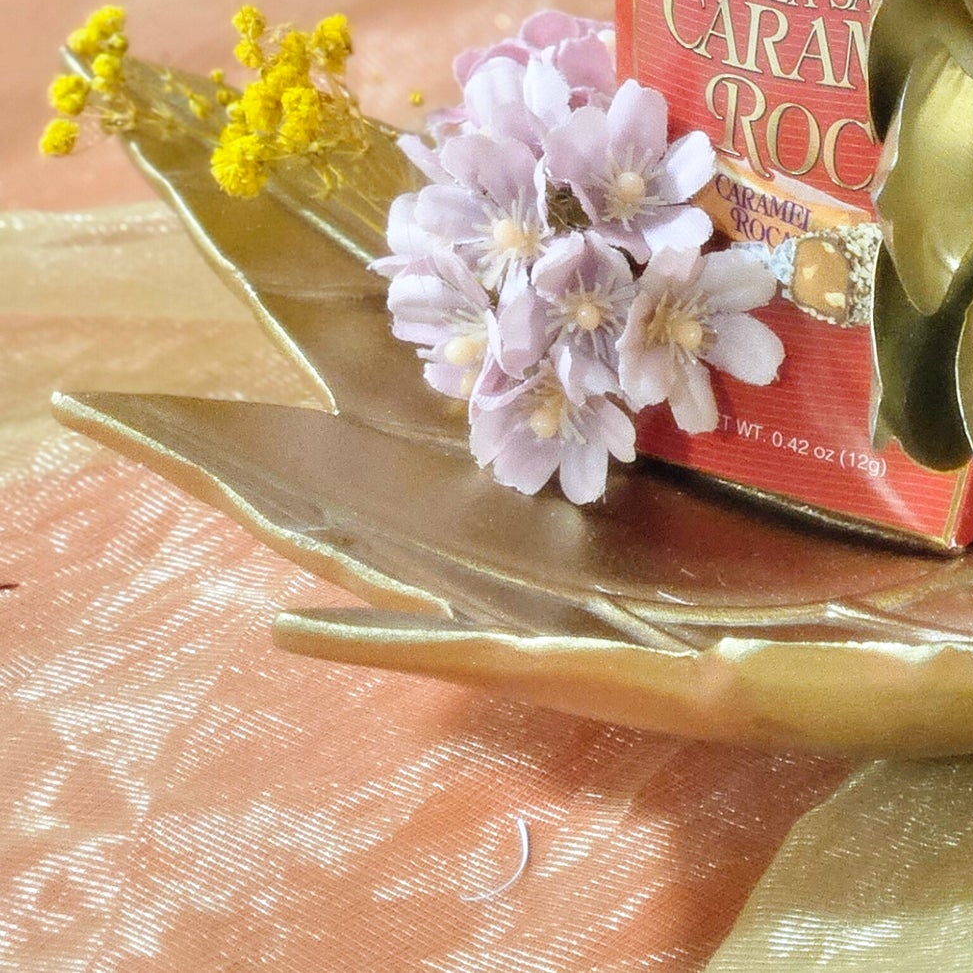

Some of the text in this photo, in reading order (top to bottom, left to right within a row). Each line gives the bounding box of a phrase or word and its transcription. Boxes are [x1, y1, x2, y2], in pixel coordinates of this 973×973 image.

[736, 418, 767, 444] WT.
[772, 431, 810, 456] 0.42
[814, 445, 835, 463] oz
[839, 449, 887, 477] (12g)
